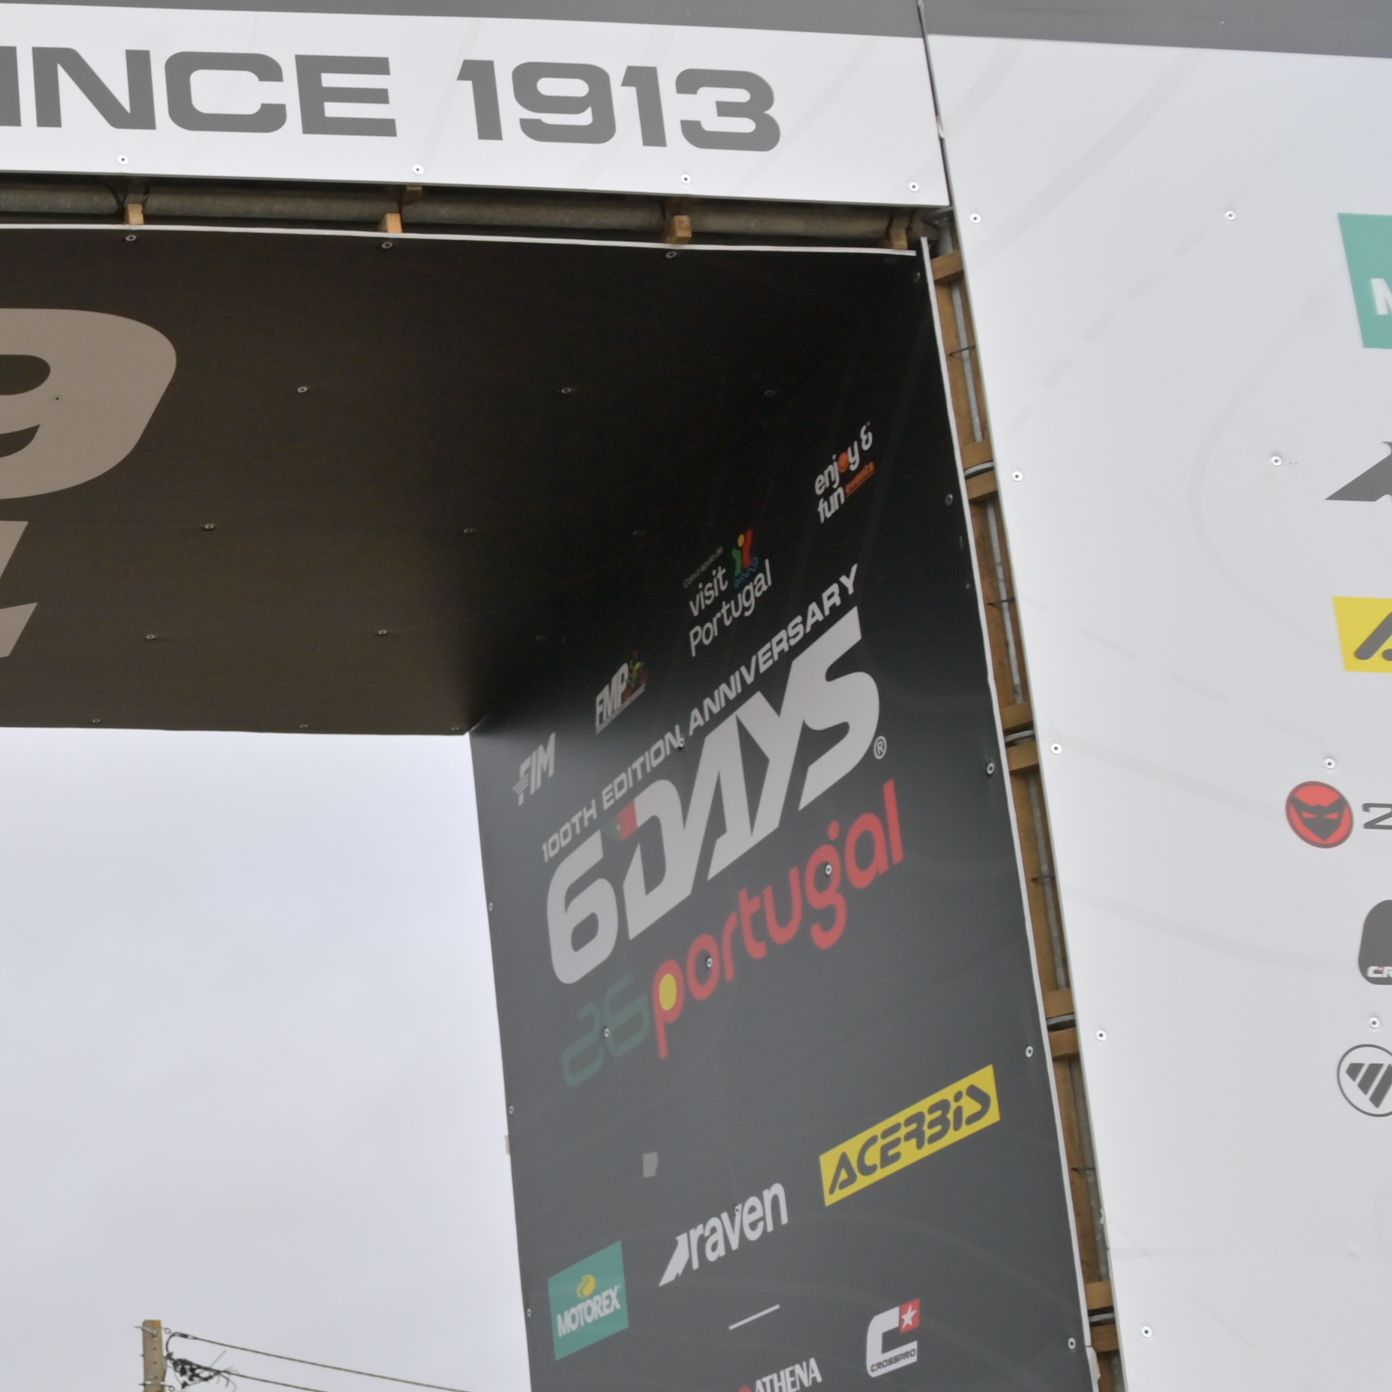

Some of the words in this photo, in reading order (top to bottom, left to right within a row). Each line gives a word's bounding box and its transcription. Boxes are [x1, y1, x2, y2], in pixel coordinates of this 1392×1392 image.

[455, 59, 782, 152] 1913
[817, 486, 845, 524] fun
[689, 565, 728, 617] visit
[689, 558, 772, 657] Portugal
[542, 798, 598, 862] 100TH
[601, 724, 683, 811] EDITION
[688, 563, 858, 737] ANNIVERSARY
[512, 732, 556, 806] FIM
[689, 1183, 788, 1270] raven
[556, 1286, 621, 1338] MOTOREX
[870, 1348, 916, 1373] CROSSPRO
